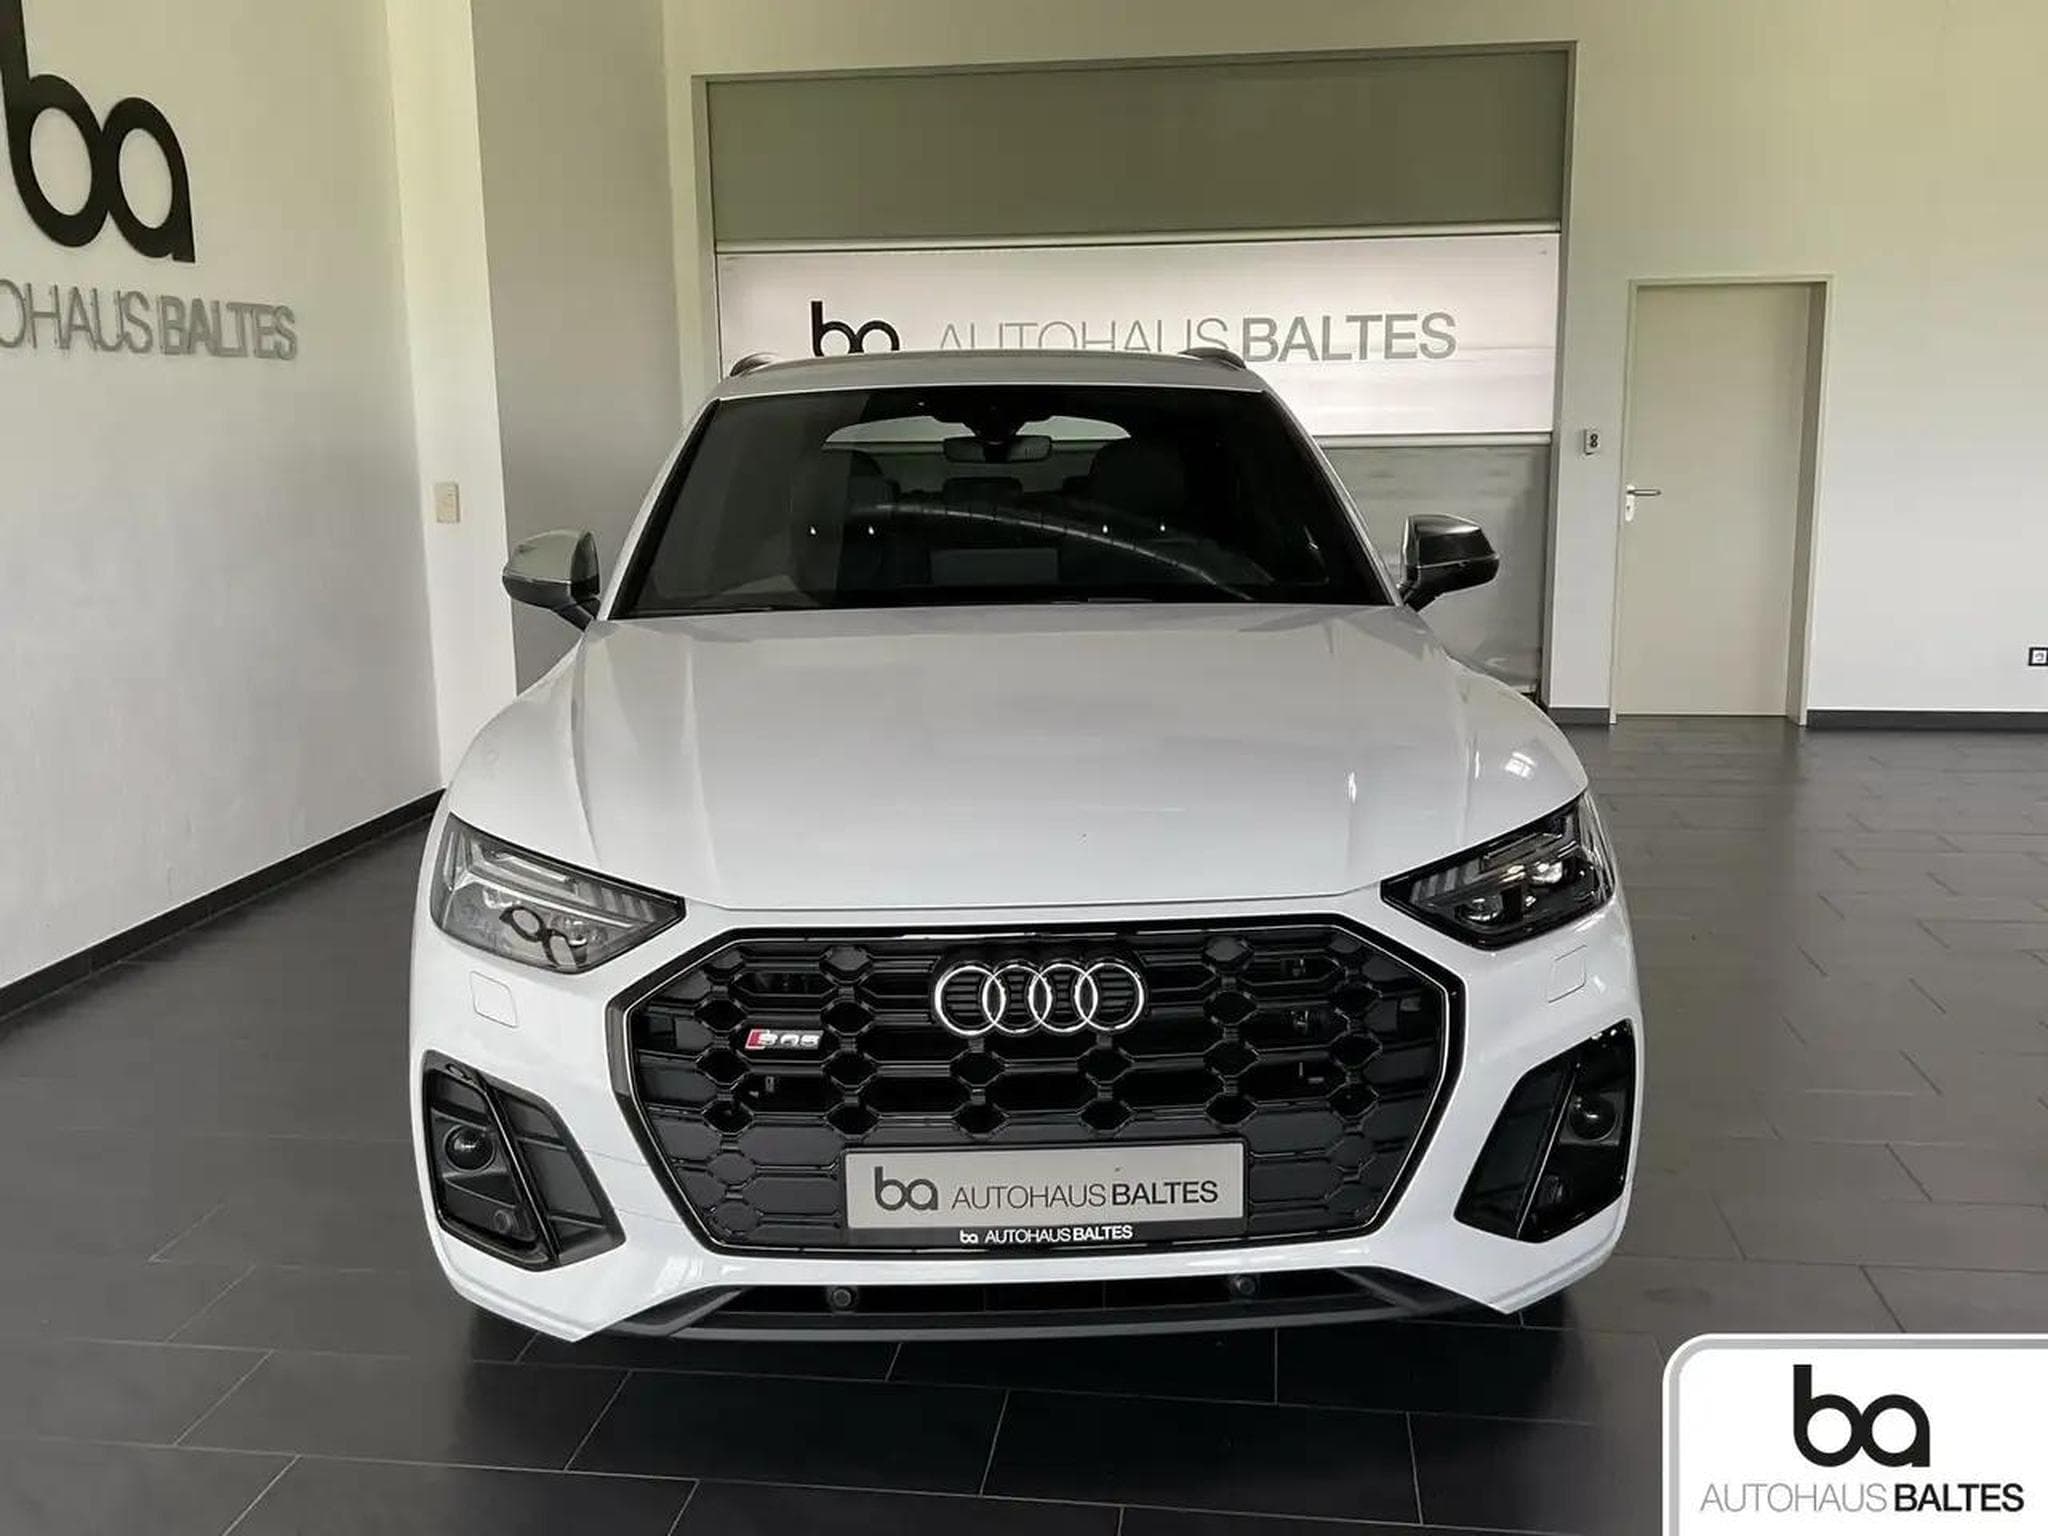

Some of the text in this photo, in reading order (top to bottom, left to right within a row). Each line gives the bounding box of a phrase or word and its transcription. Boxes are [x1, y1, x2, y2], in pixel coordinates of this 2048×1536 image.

[0, 0, 195, 263] ba
[156, 295, 298, 360] BALTES
[1243, 312, 1457, 362] BALTES
[874, 1166, 1218, 1211] ba AUTOHAUS BALTES
[960, 1225, 1133, 1244] ba AUTOHAUS BALTES
